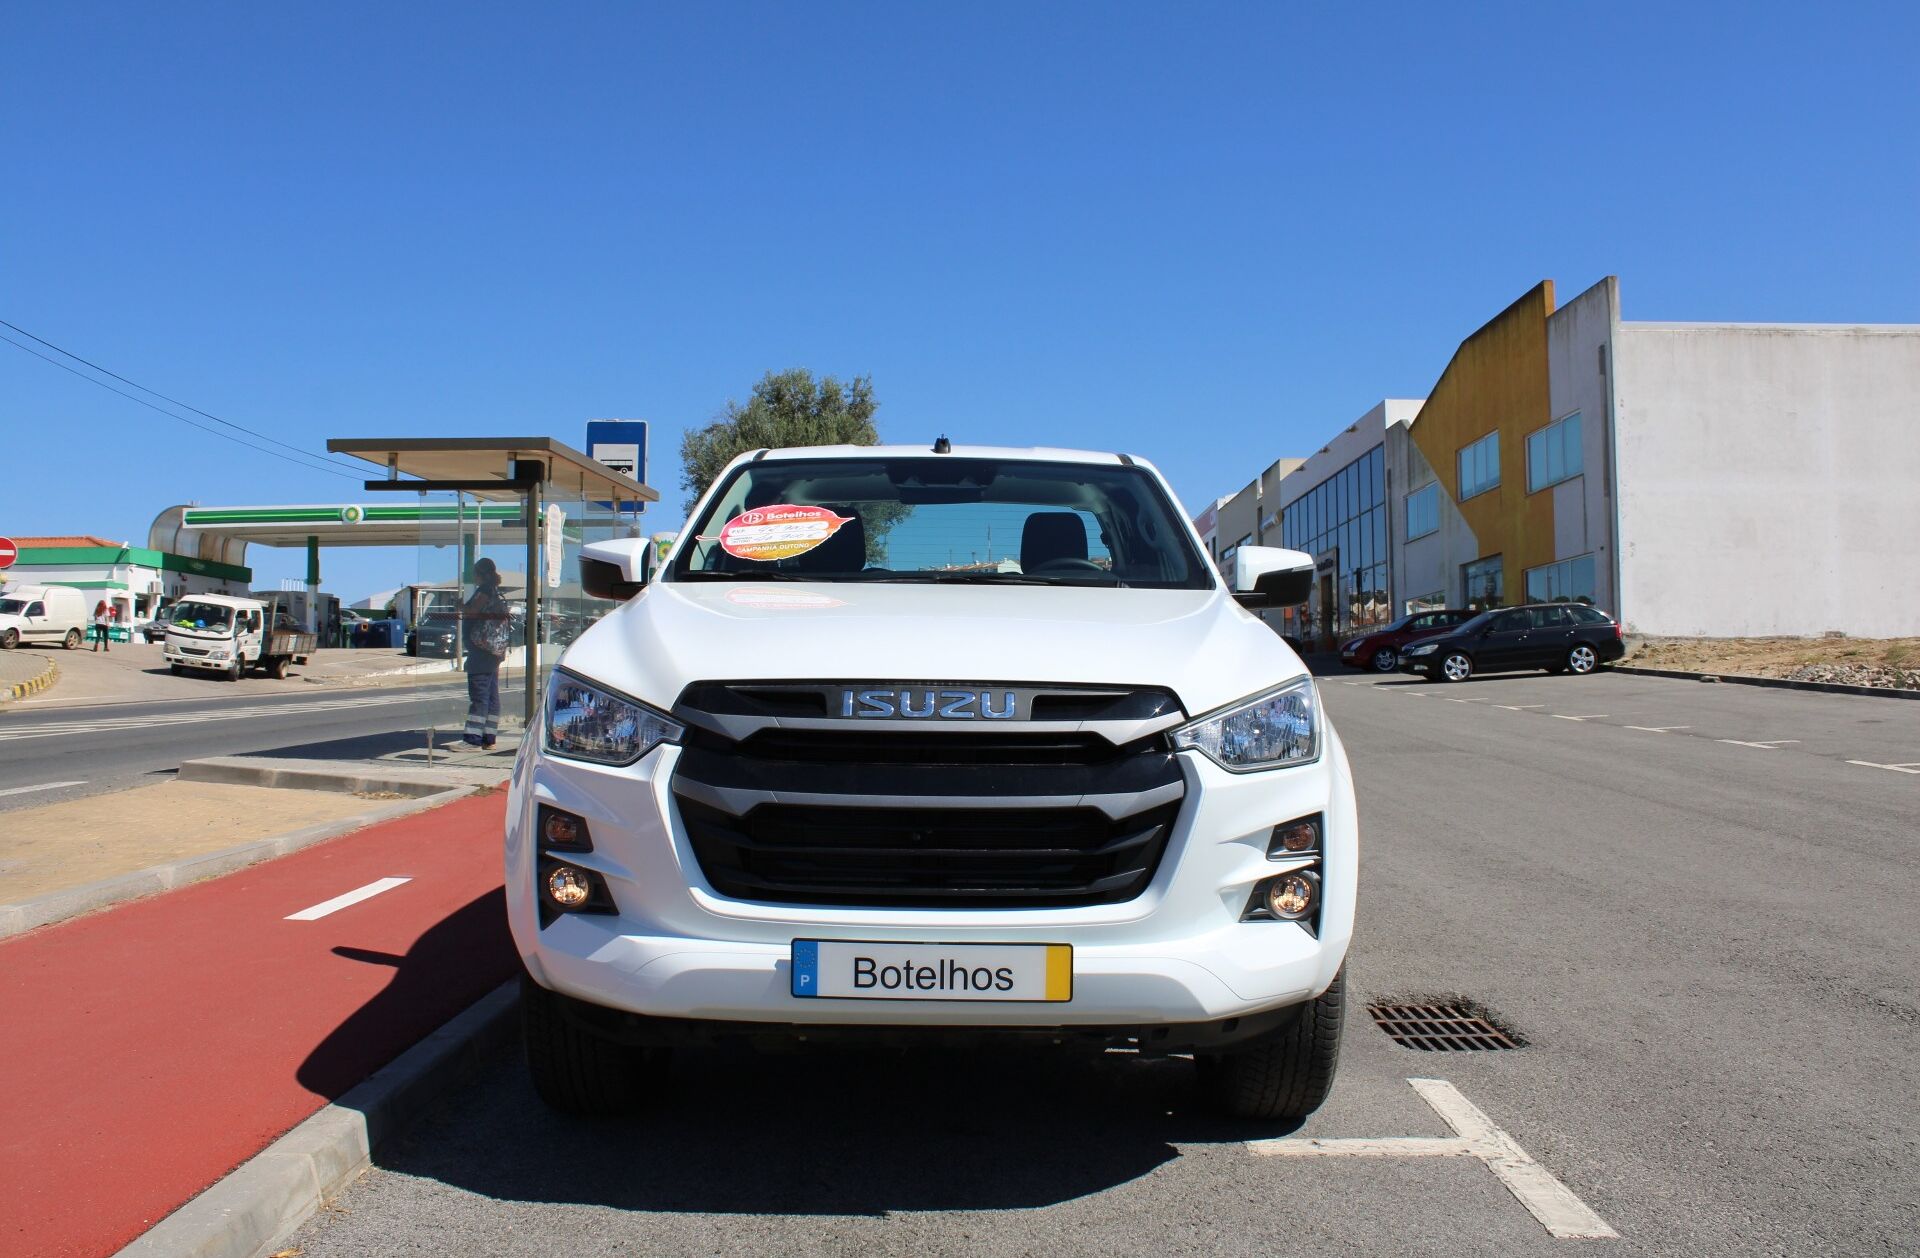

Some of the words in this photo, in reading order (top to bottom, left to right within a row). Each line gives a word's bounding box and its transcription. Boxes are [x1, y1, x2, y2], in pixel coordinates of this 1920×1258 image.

[766, 511, 822, 520] Botelhos
[736, 544, 778, 553] CAMPANHA
[779, 542, 810, 550] OUTONO
[841, 689, 1016, 719] ISUZU
[800, 974, 810, 987] P
[853, 957, 1014, 991] Botelhos
